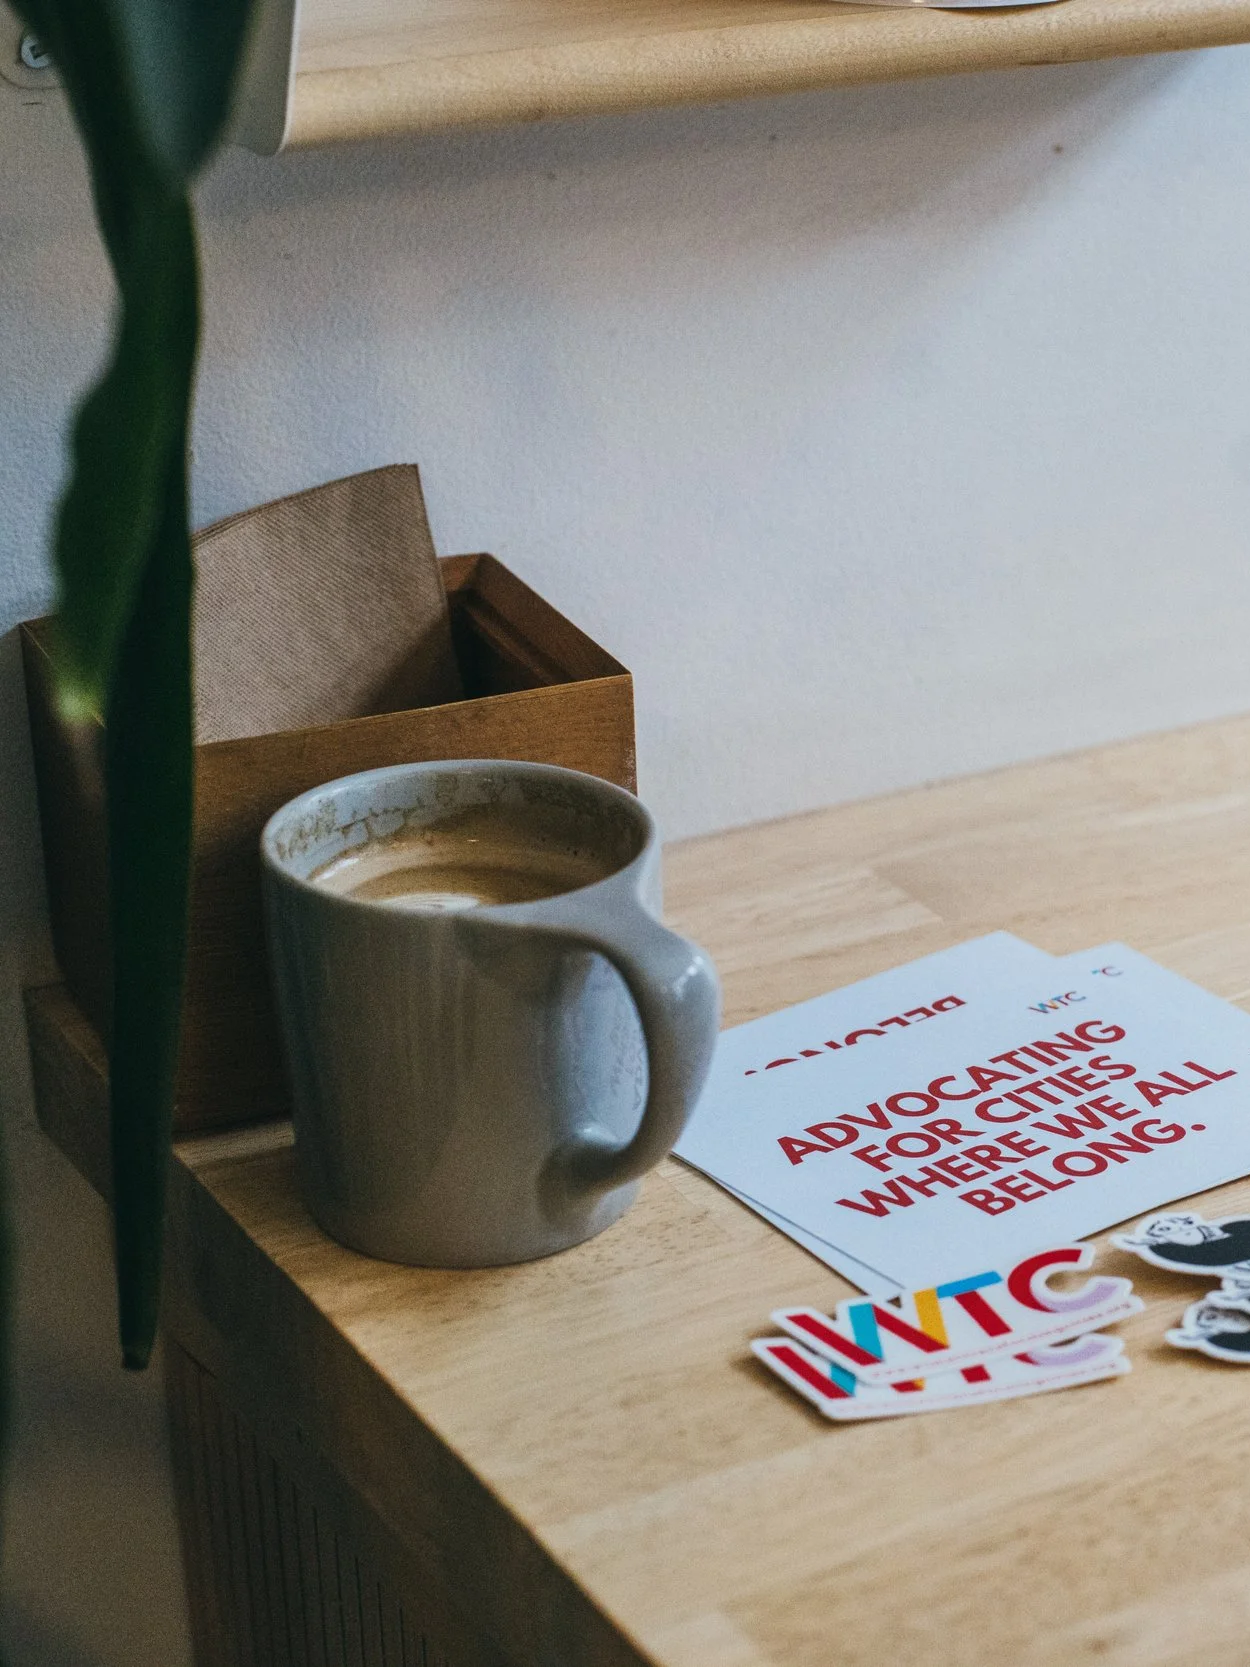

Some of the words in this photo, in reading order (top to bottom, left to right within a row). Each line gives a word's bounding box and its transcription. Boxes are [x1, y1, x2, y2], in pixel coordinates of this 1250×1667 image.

[1027, 990, 1087, 1014] WTC
[776, 1020, 1126, 1166] ADVOCATING
[834, 1130, 1051, 1218] WHERE
[1030, 1094, 1141, 1140] WE
[1133, 1060, 1238, 1108] ALL
[850, 1117, 987, 1173] FOR
[974, 1055, 1137, 1123] CITIES
[958, 1118, 1207, 1216] BELONG.
[785, 1248, 1119, 1367] WTC
